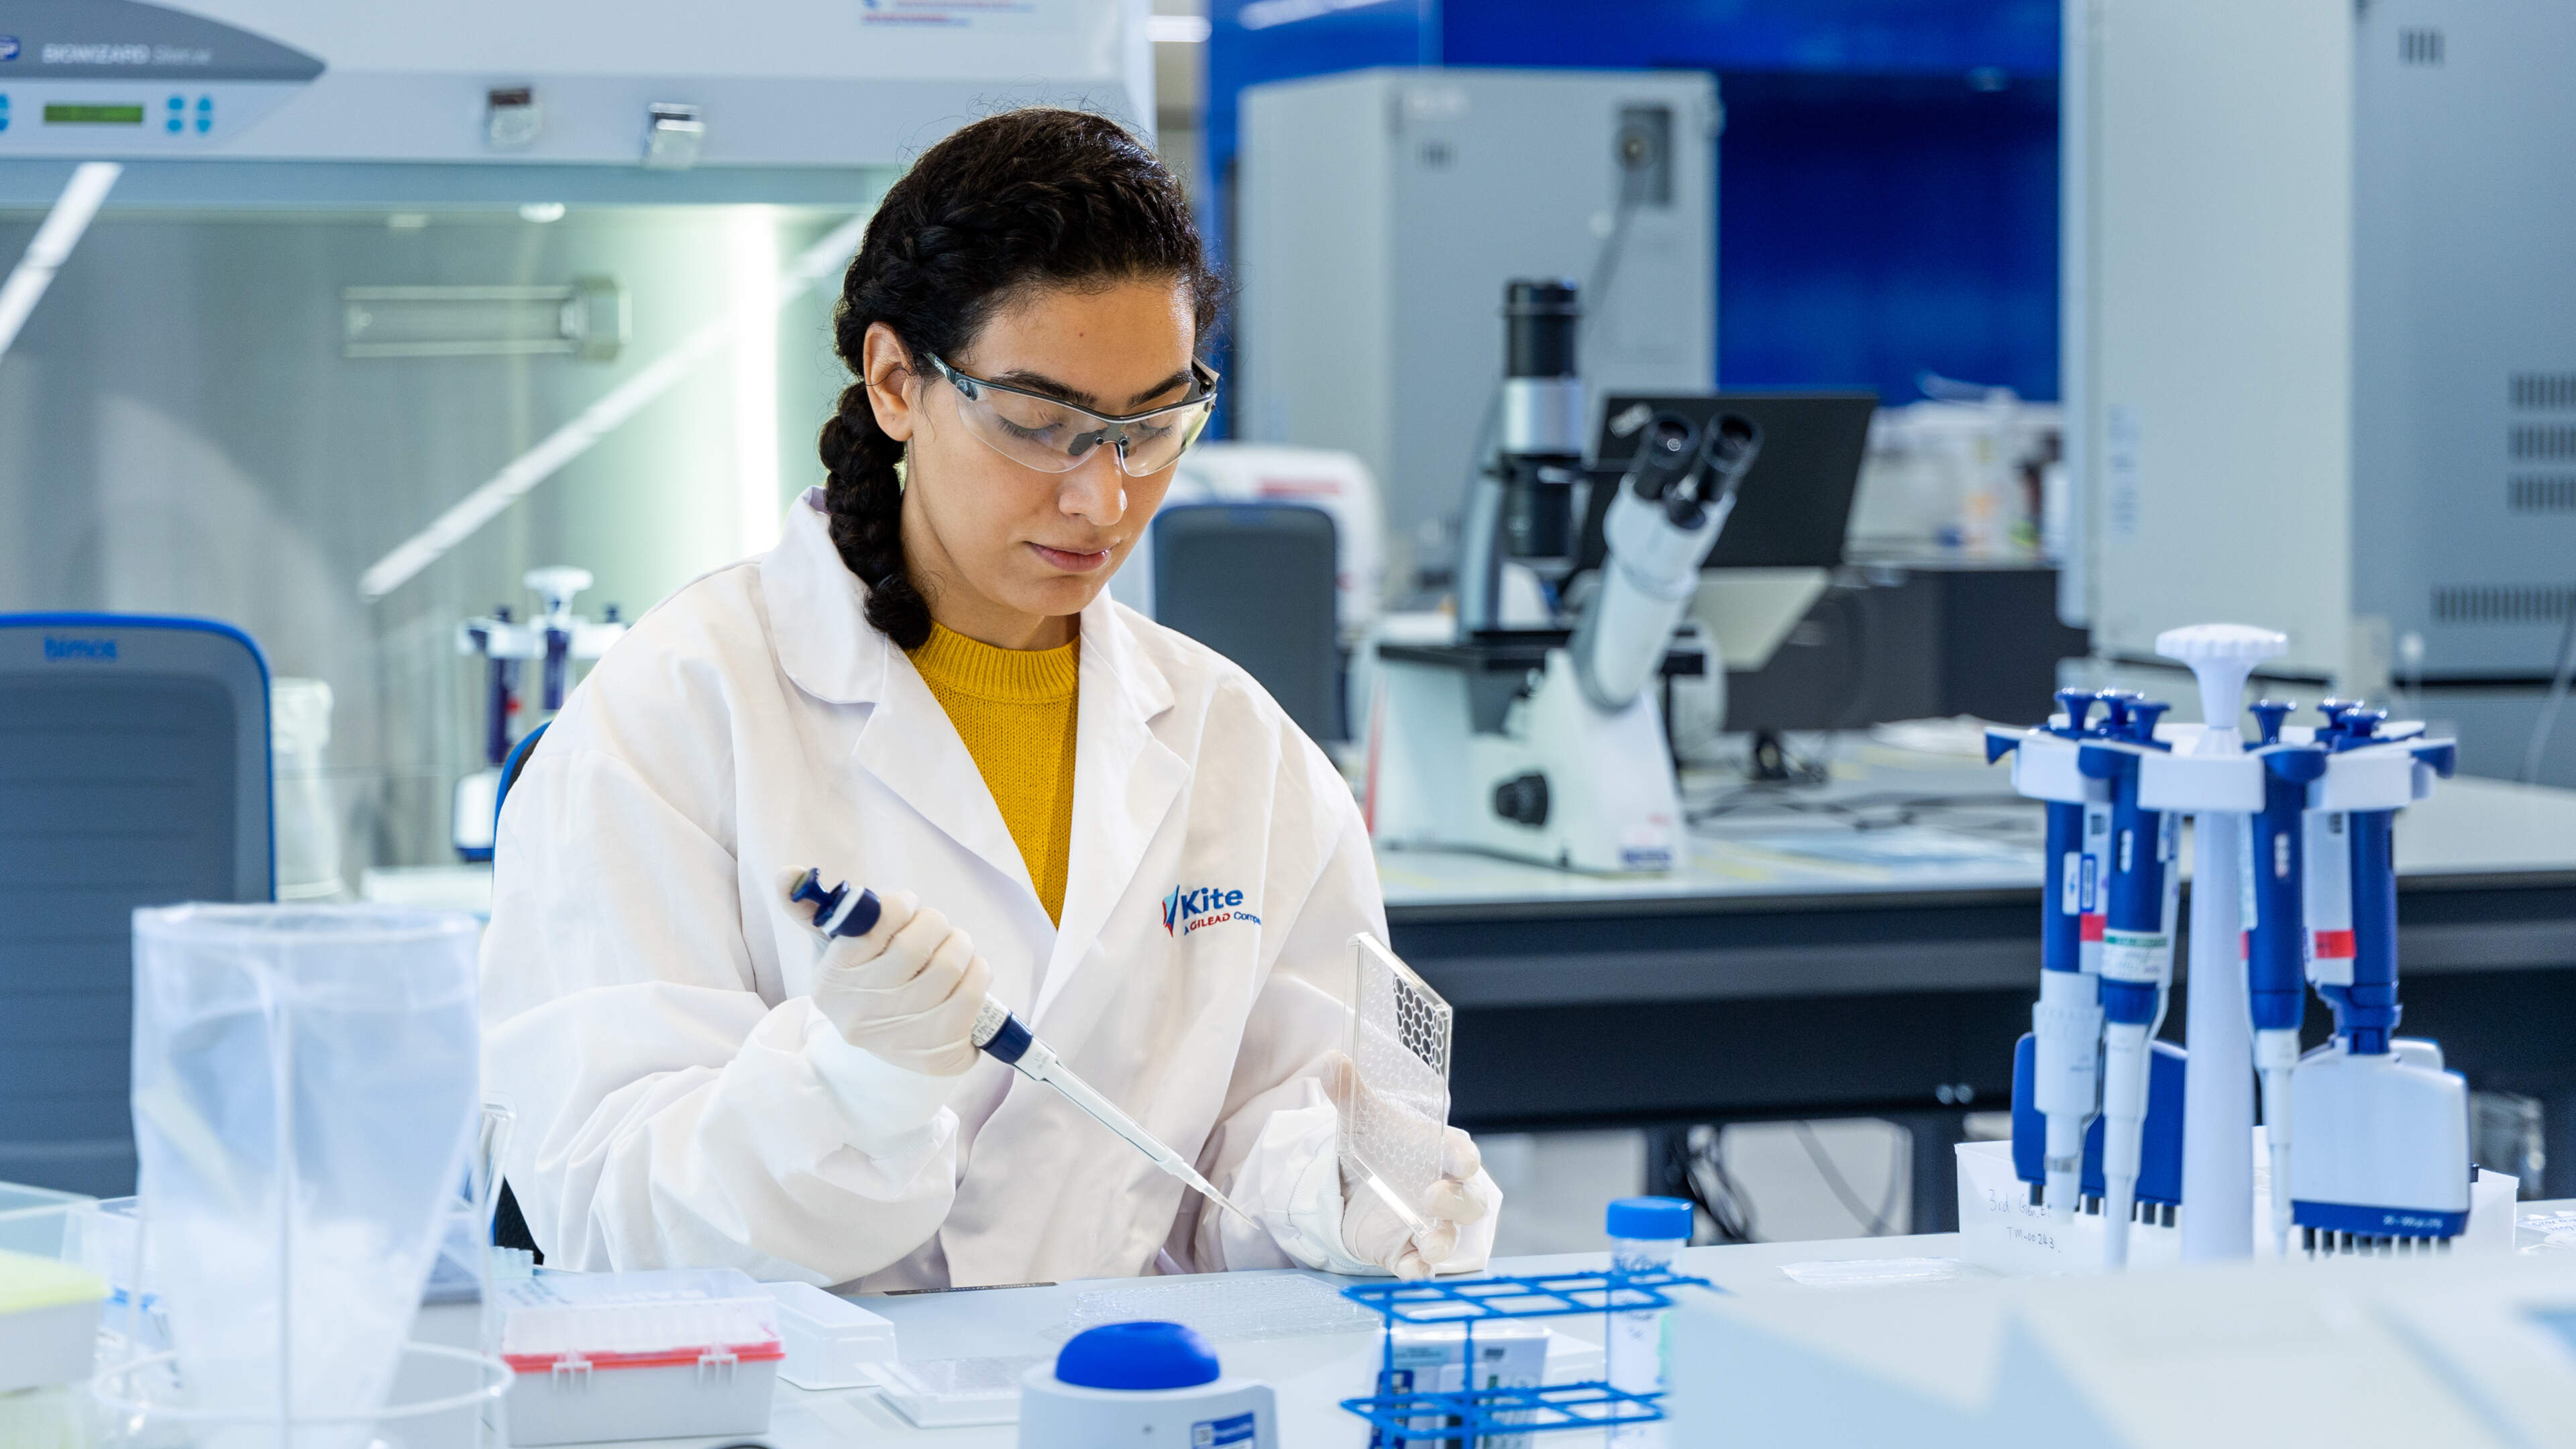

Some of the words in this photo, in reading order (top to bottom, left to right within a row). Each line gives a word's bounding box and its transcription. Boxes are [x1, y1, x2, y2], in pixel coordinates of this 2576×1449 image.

[1181, 887, 1244, 920] Kite
[1189, 912, 1231, 930] GILEAD
[1988, 1189, 2010, 1214] 3rd
